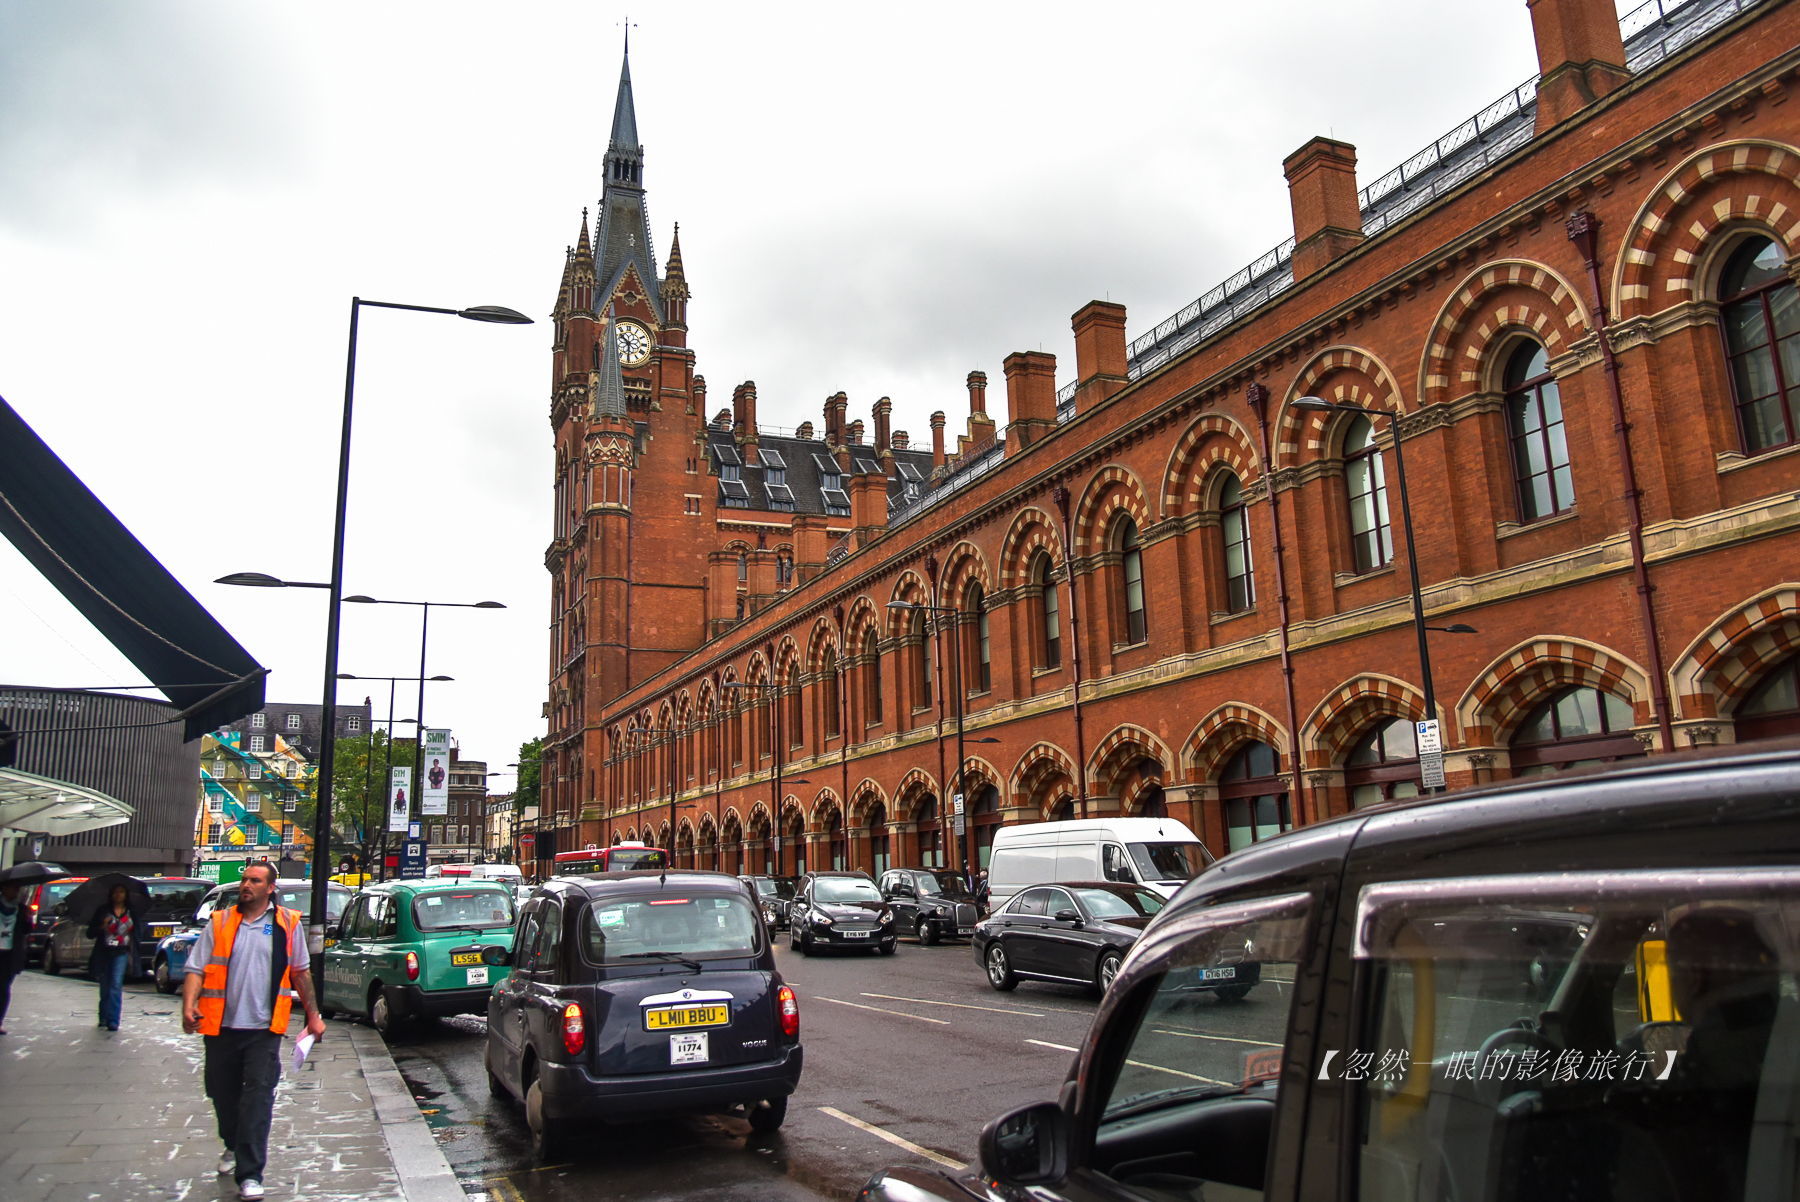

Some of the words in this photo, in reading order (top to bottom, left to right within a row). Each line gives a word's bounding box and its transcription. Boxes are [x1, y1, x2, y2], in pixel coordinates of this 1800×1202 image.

[427, 732, 446, 743] SWIM
[456, 954, 478, 963] LS56
[659, 1010, 685, 1025] LM11
[689, 1008, 716, 1023] BBU
[678, 1044, 702, 1052] 11774
[742, 1040, 767, 1048] VOGUE
